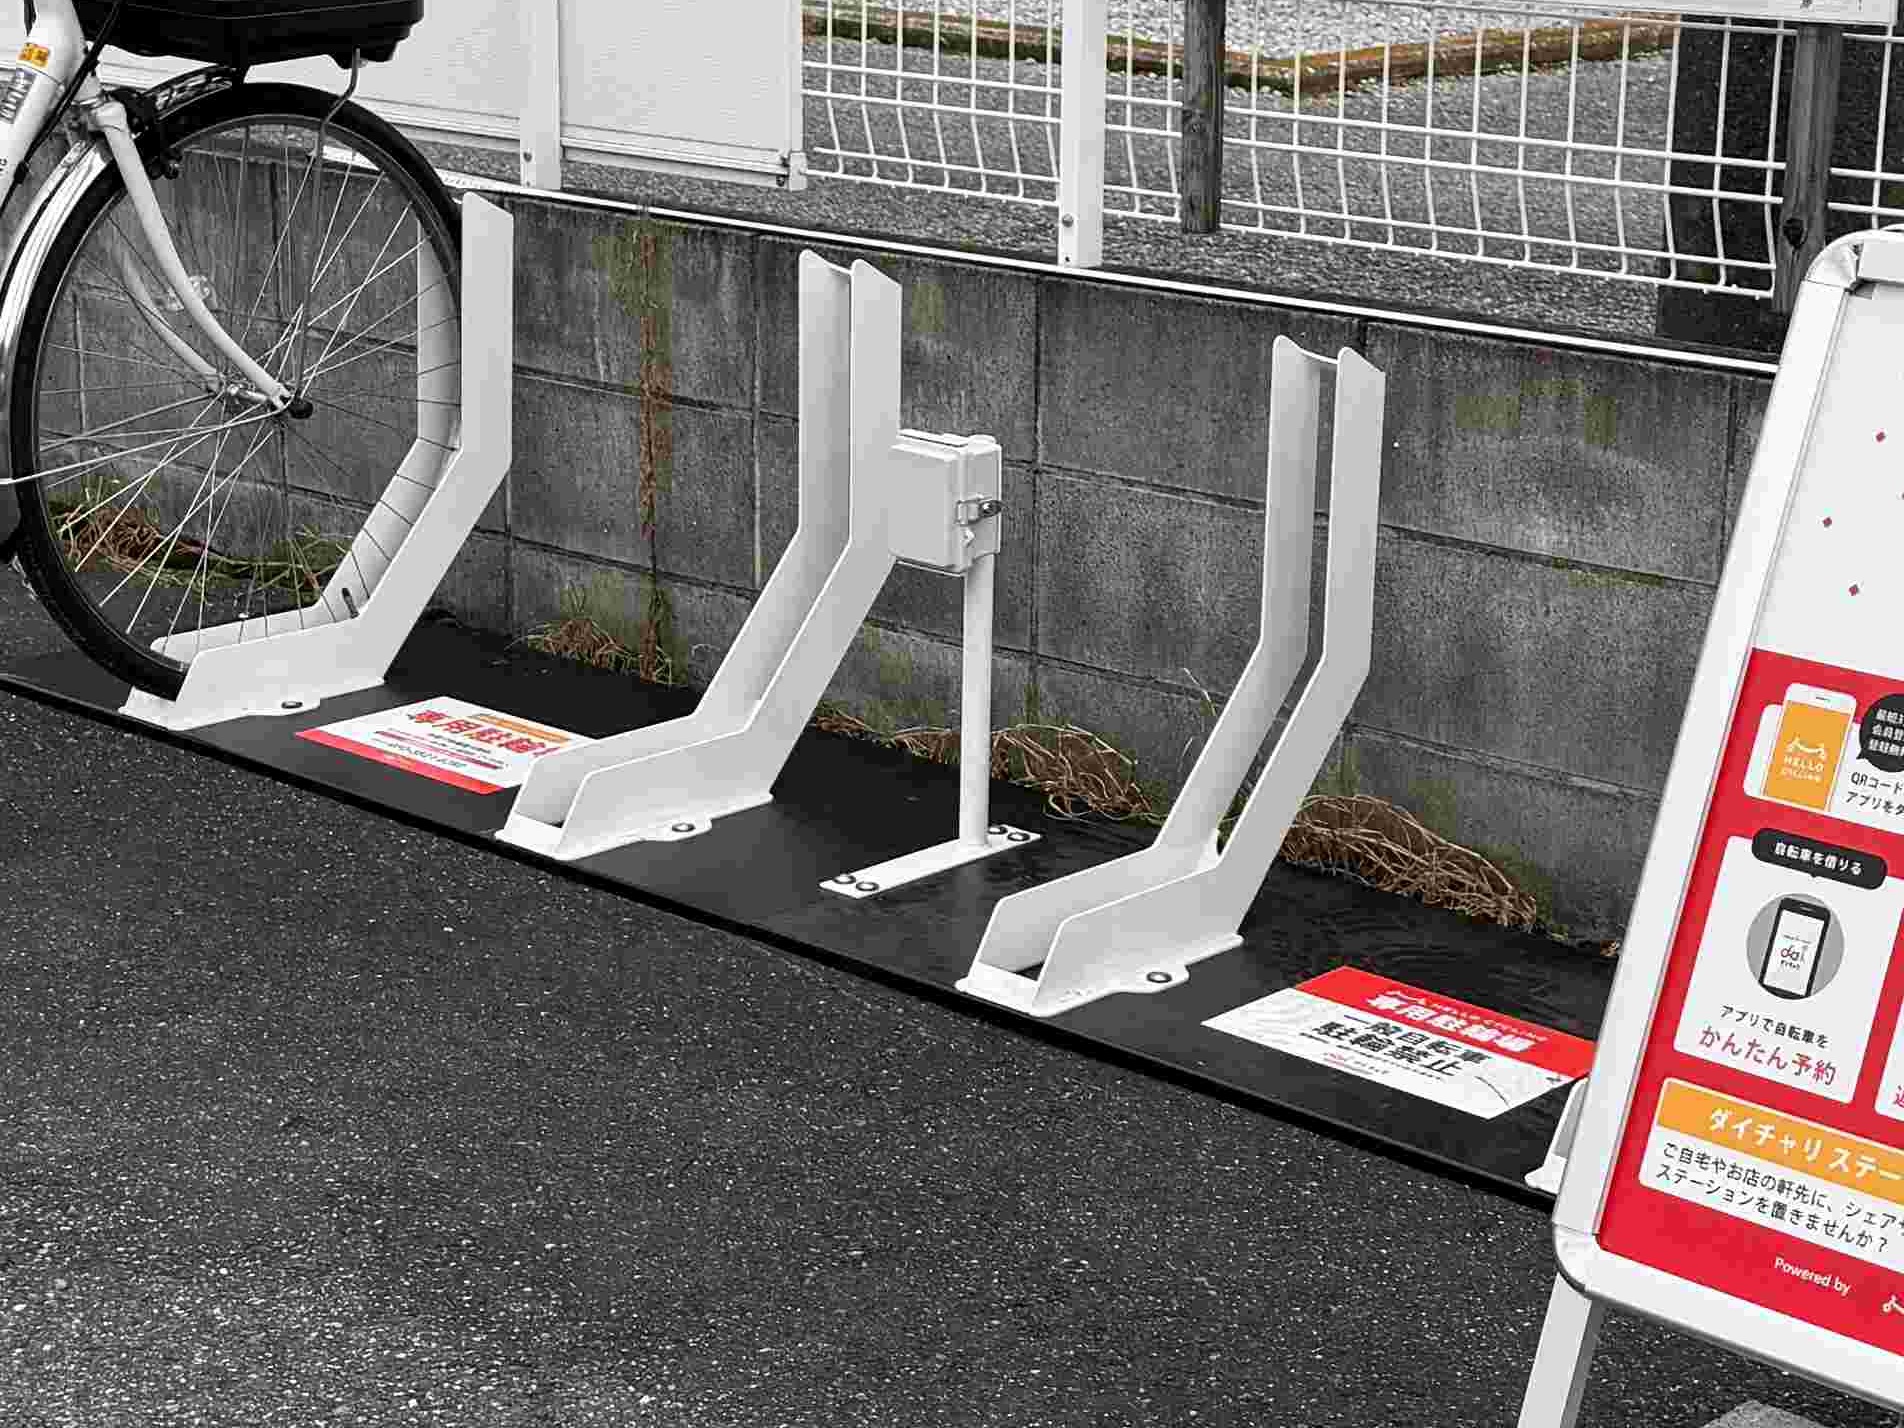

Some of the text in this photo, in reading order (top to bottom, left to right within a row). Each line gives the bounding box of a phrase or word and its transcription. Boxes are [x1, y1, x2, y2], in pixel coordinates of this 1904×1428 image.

[408, 709, 562, 757] 専用駐輪
[1774, 841, 1863, 876] 自転車を借りる
[1311, 1021, 1463, 1077] 駐輪禁止
[1720, 1005, 1829, 1049] アプリで自転車を
[1699, 1026, 1836, 1086] かんたん予約
[1708, 1106, 1822, 1163] ダイチャリ
[1655, 1163, 1890, 1255] ステーションを置きませんか？
[1773, 1255, 1853, 1298] Powered by
